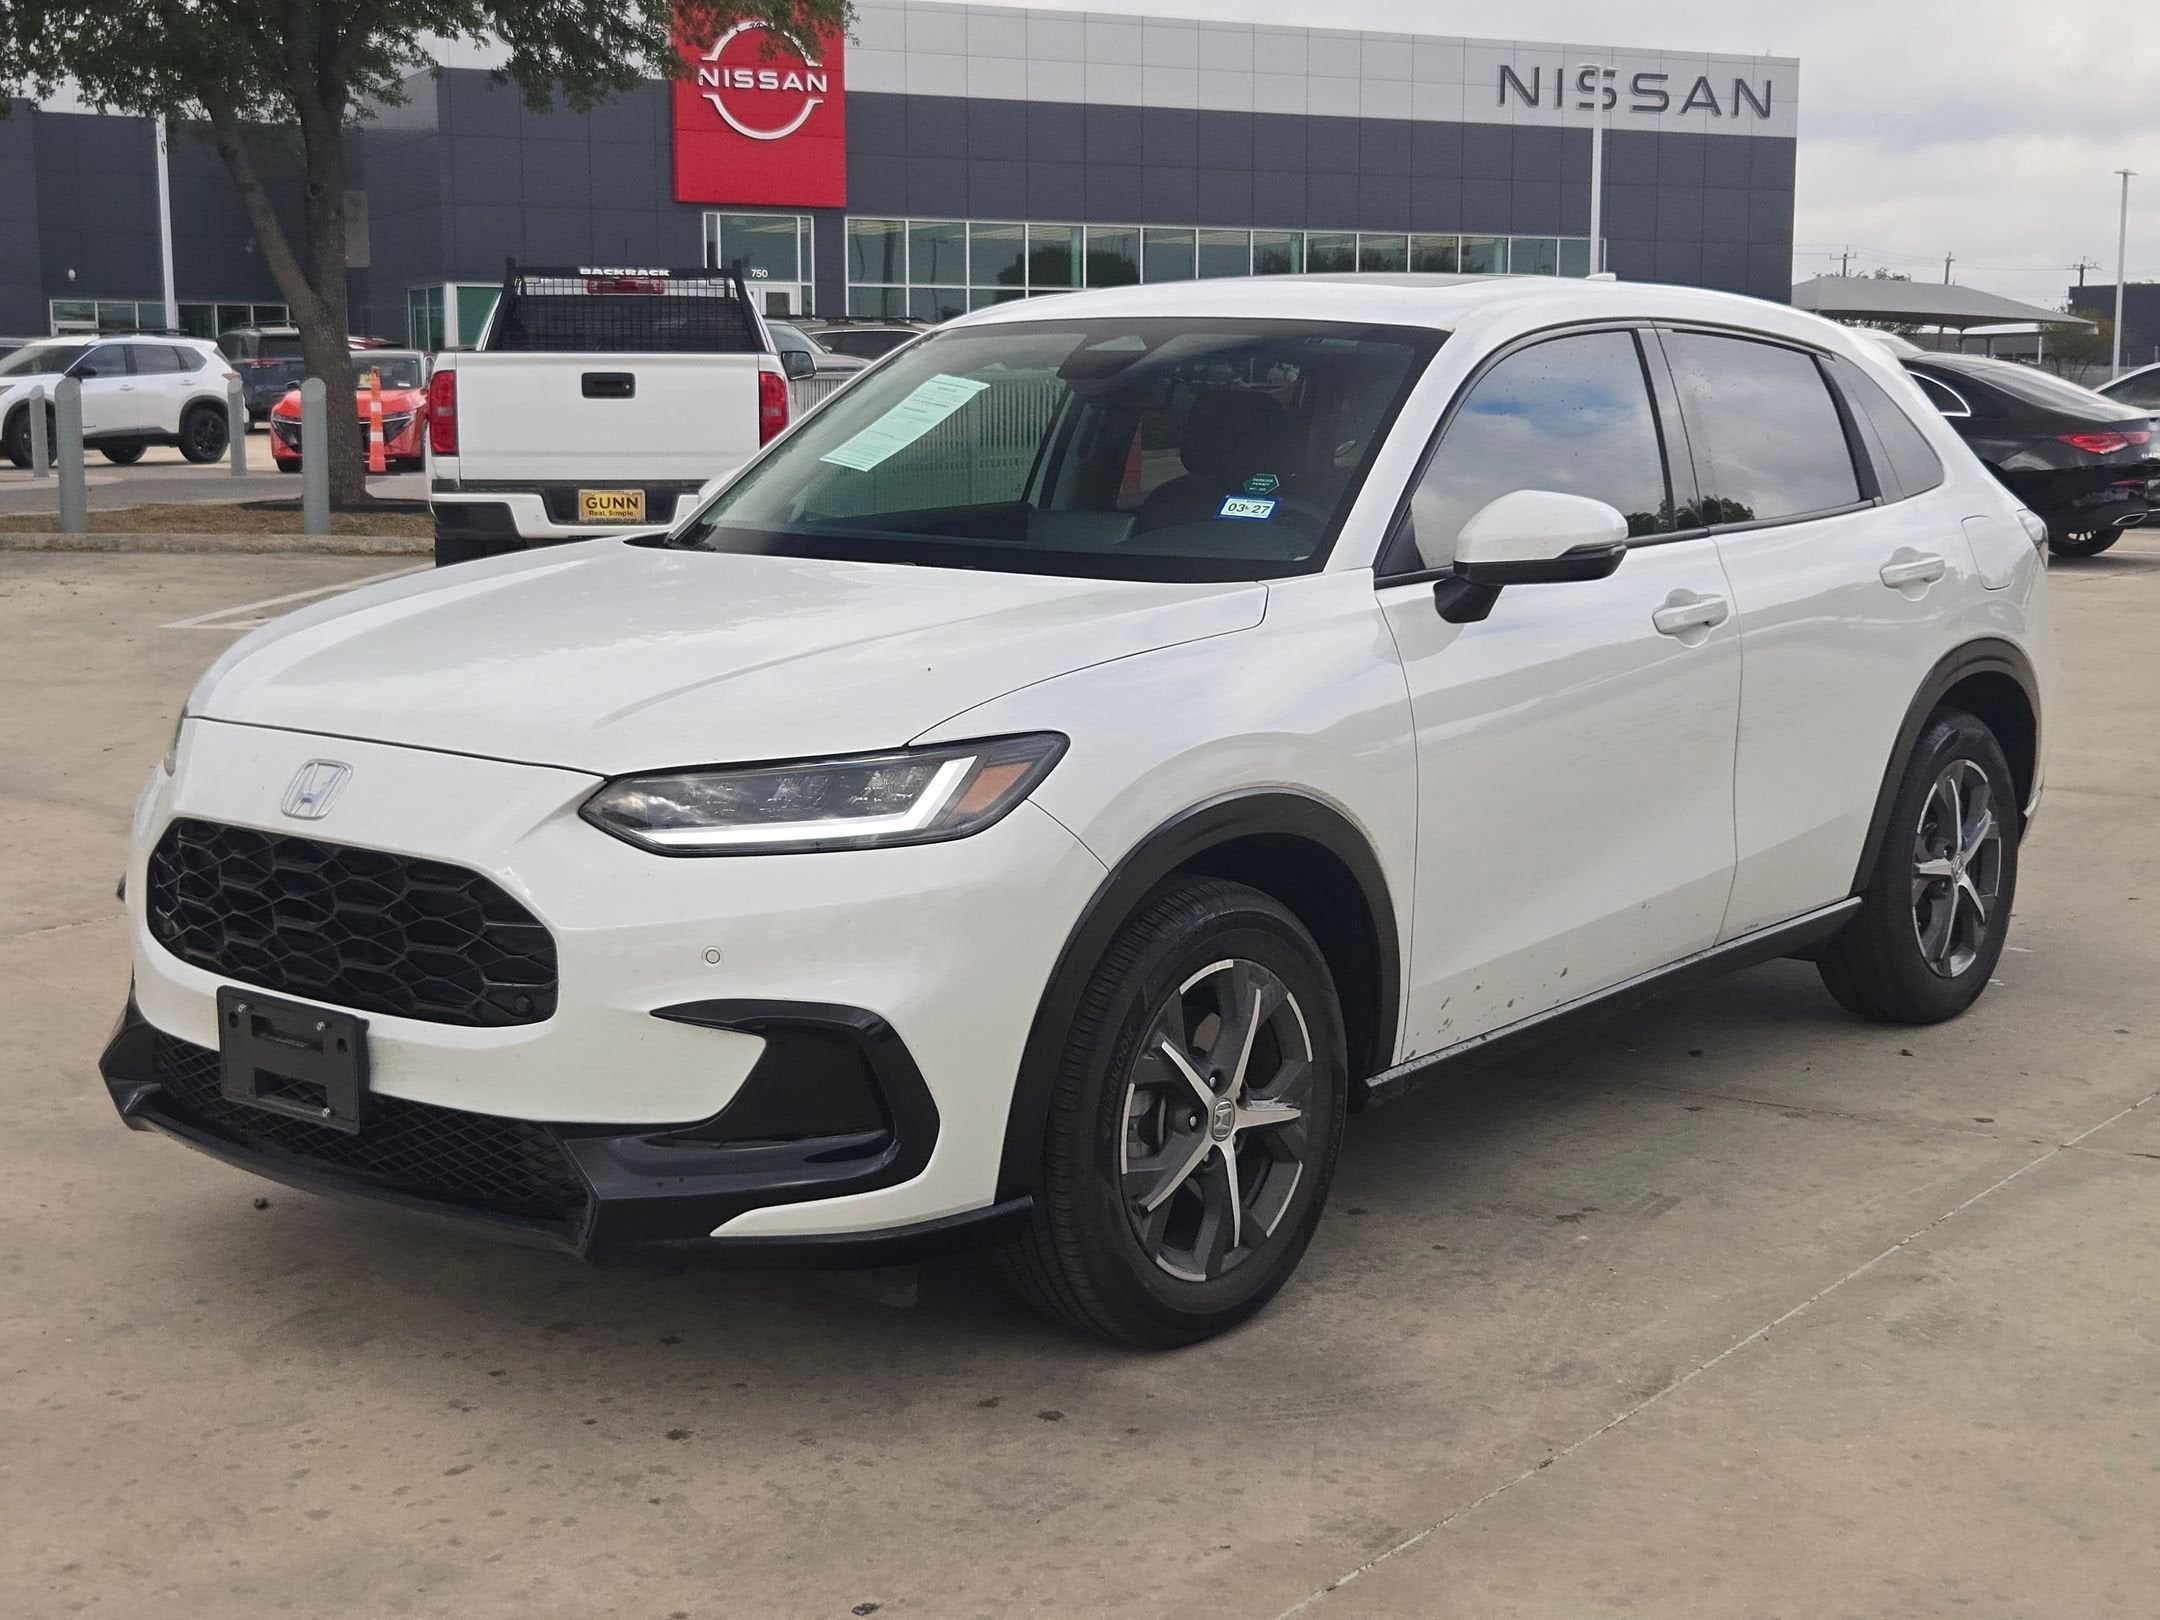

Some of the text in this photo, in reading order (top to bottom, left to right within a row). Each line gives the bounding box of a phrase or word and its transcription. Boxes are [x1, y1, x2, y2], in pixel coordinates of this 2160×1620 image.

[698, 68, 828, 92] NISSAN
[1498, 64, 1772, 120] NISSAN
[580, 268, 670, 276] BACKRACK
[751, 268, 769, 278] 750
[586, 496, 639, 509] GUNN
[1251, 504, 1271, 514] 27
